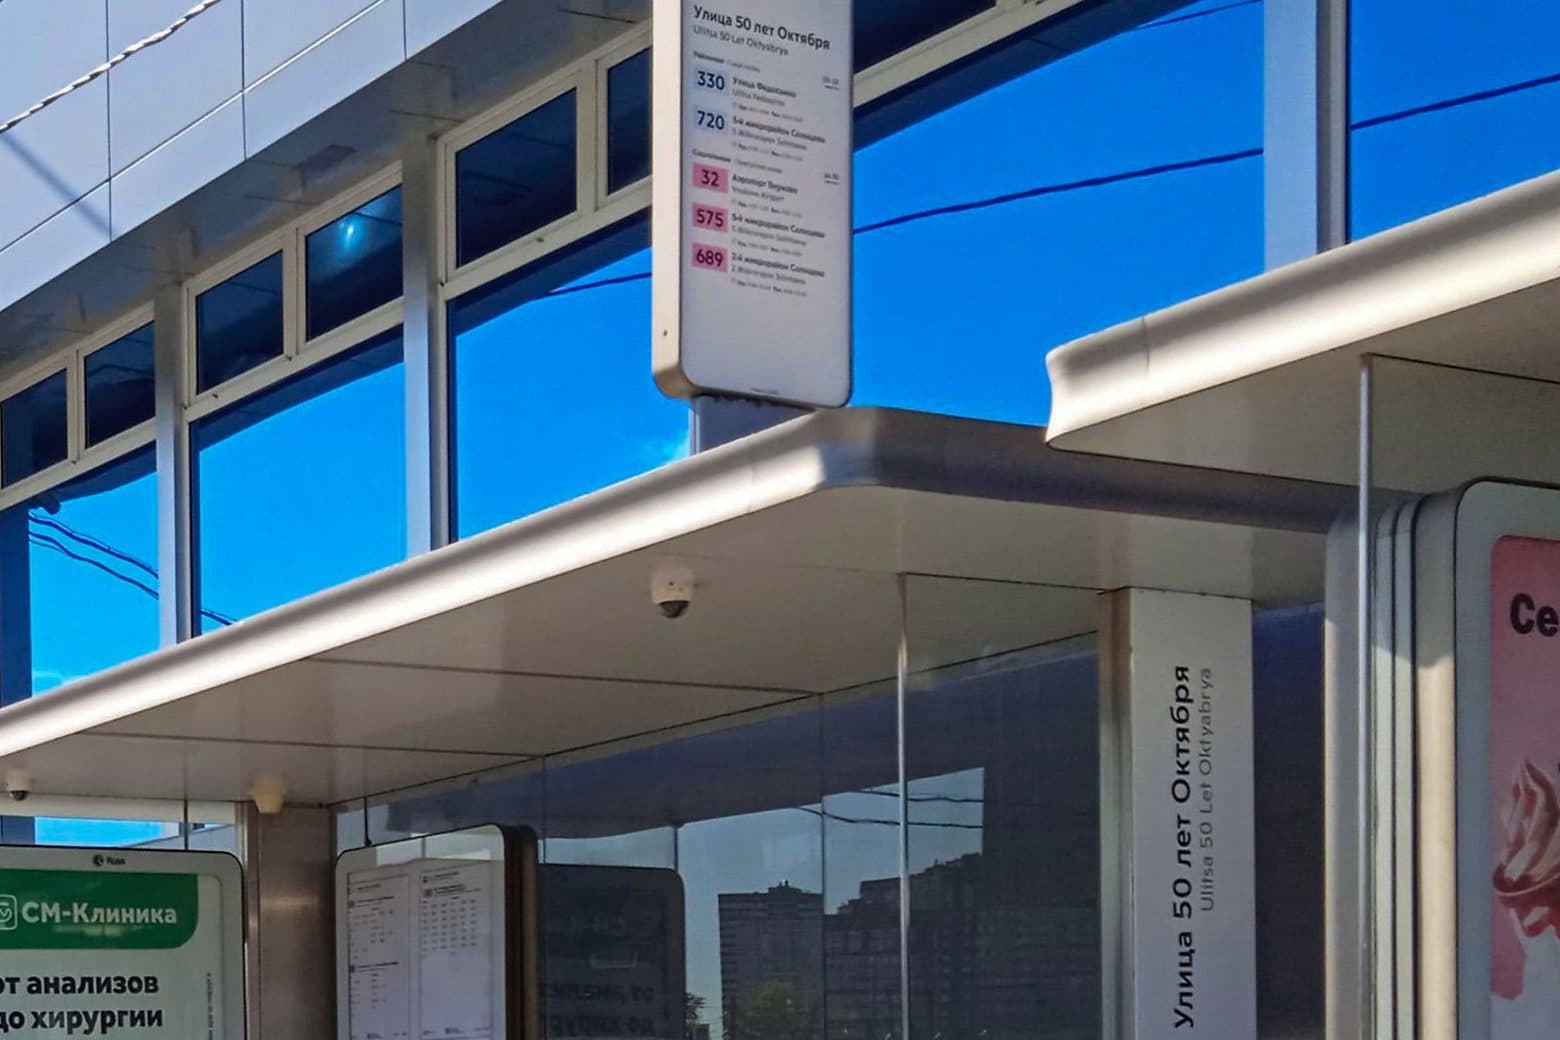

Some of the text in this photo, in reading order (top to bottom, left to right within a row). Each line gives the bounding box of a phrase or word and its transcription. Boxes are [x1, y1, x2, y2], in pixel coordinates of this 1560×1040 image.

[694, 5, 830, 50] Улица 50 лет Октября
[720, 31, 730, 42] 50
[697, 70, 725, 91] 330
[697, 110, 725, 130] 720
[701, 169, 719, 188] 32
[696, 208, 724, 228] 575
[696, 248, 723, 268] 689
[1198, 668, 1214, 912] Ulitsa 50 Let Oktyabrya
[1170, 666, 1195, 1028] Улица 50 лет Октября
[22, 901, 177, 924] СМ-Клиника
[27, 975, 159, 994] анализов
[32, 1009, 163, 1035] хирургии
